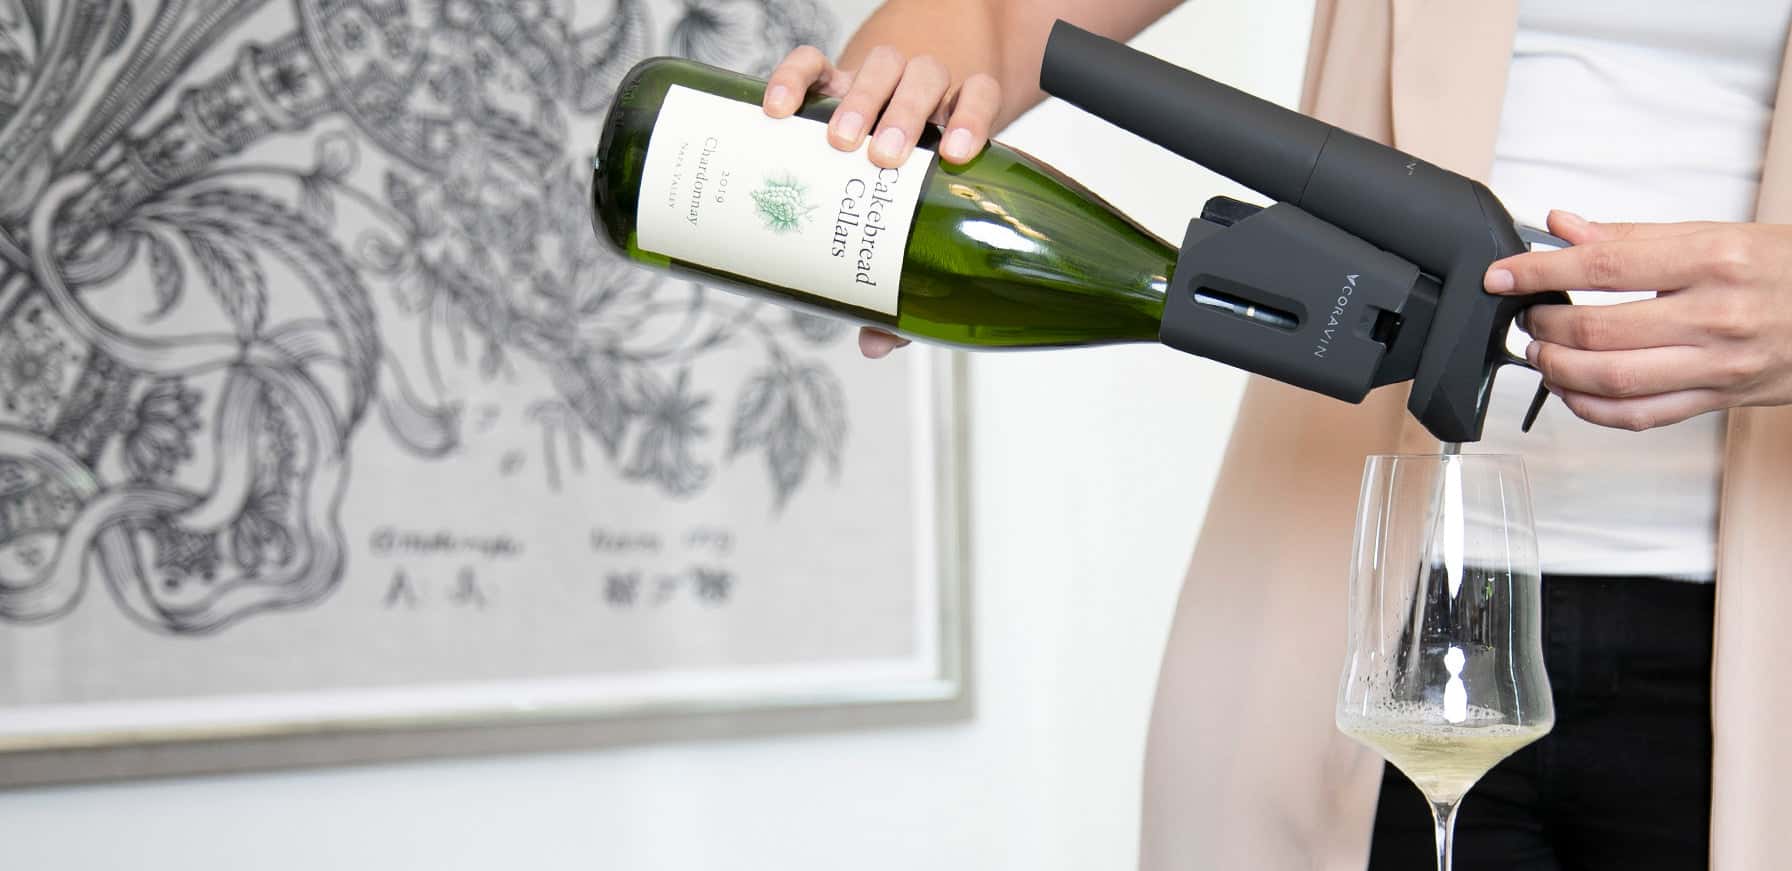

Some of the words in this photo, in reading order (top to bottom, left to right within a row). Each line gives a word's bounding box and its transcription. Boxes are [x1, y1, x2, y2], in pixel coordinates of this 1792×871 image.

[686, 137, 719, 226] Chardonnay
[714, 170, 730, 203] 2019
[832, 178, 865, 258] Cellars
[856, 168, 899, 287] Cakebread
[1313, 286, 1353, 358] CORAVIN
